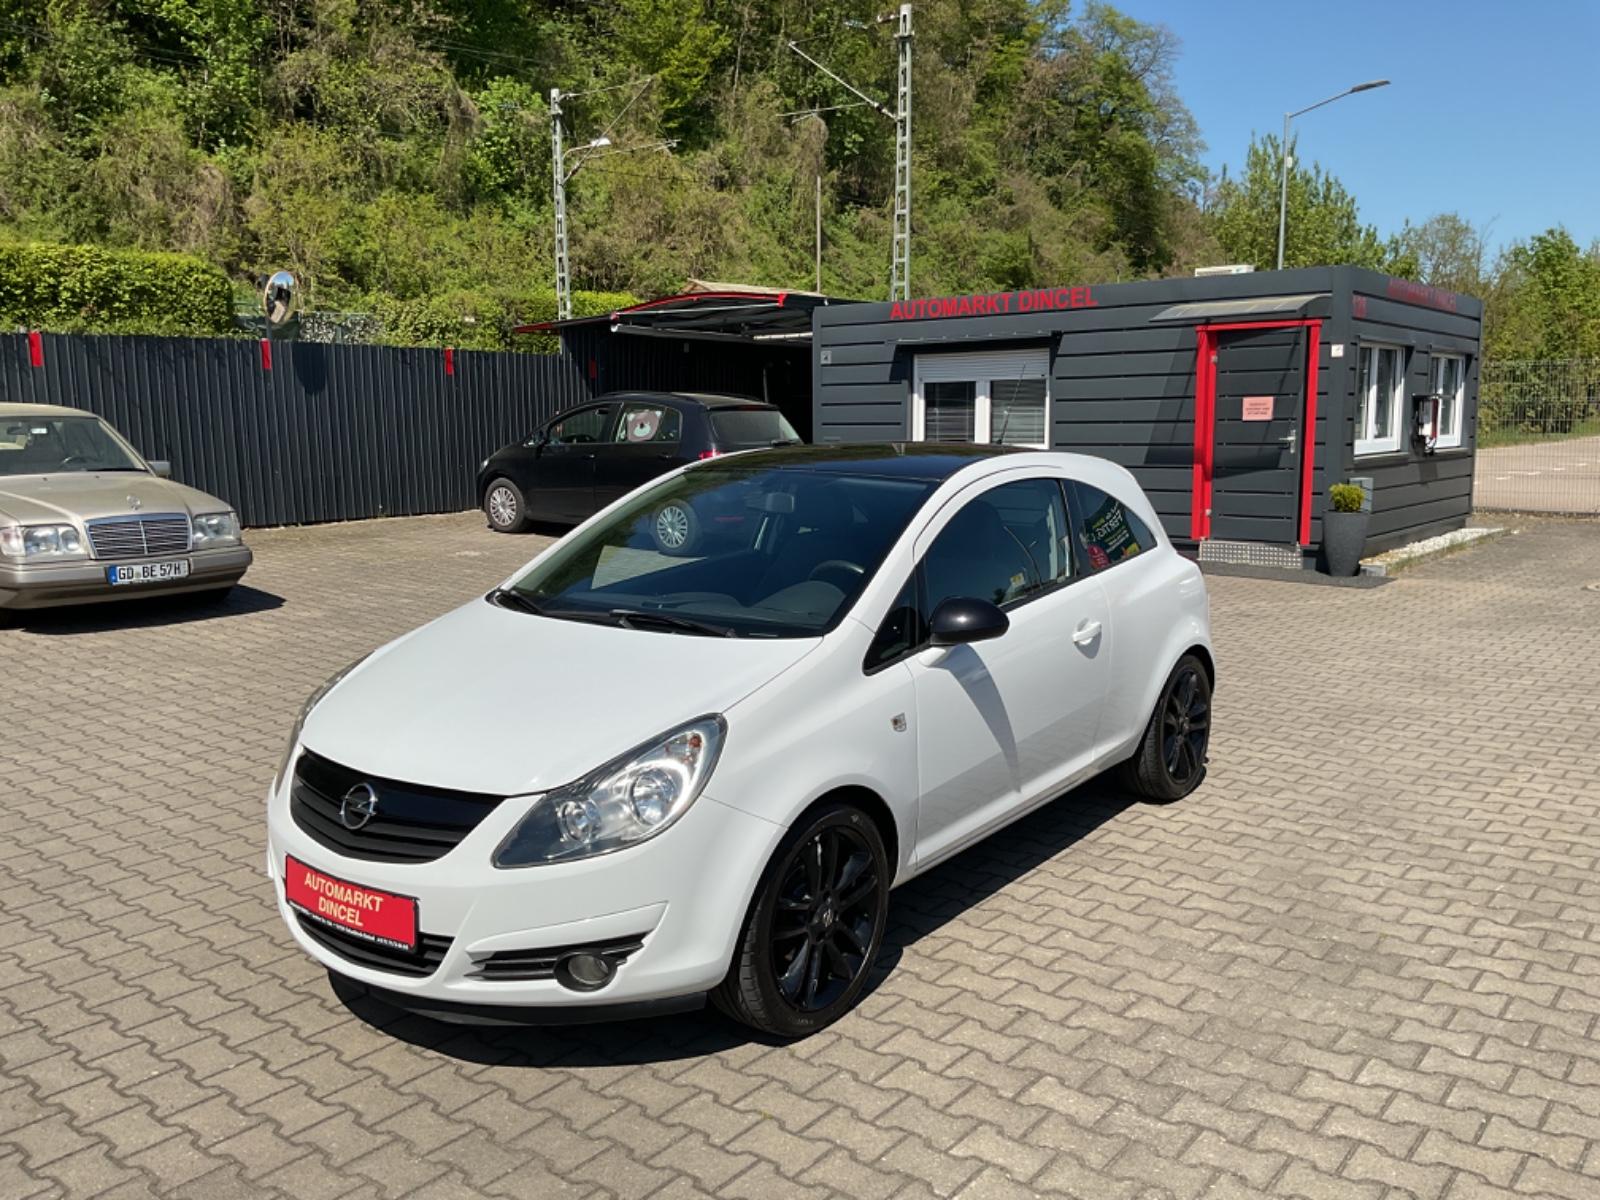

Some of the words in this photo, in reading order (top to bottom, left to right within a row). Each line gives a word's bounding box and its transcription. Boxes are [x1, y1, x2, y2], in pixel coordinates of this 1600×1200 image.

[890, 292, 1014, 320] AUTOMARKT
[1018, 287, 1098, 312] DINCEL
[118, 567, 133, 580] GD
[142, 566, 158, 578] BE
[304, 872, 383, 912] AUTOMARKT
[318, 896, 364, 927] DINCEL
